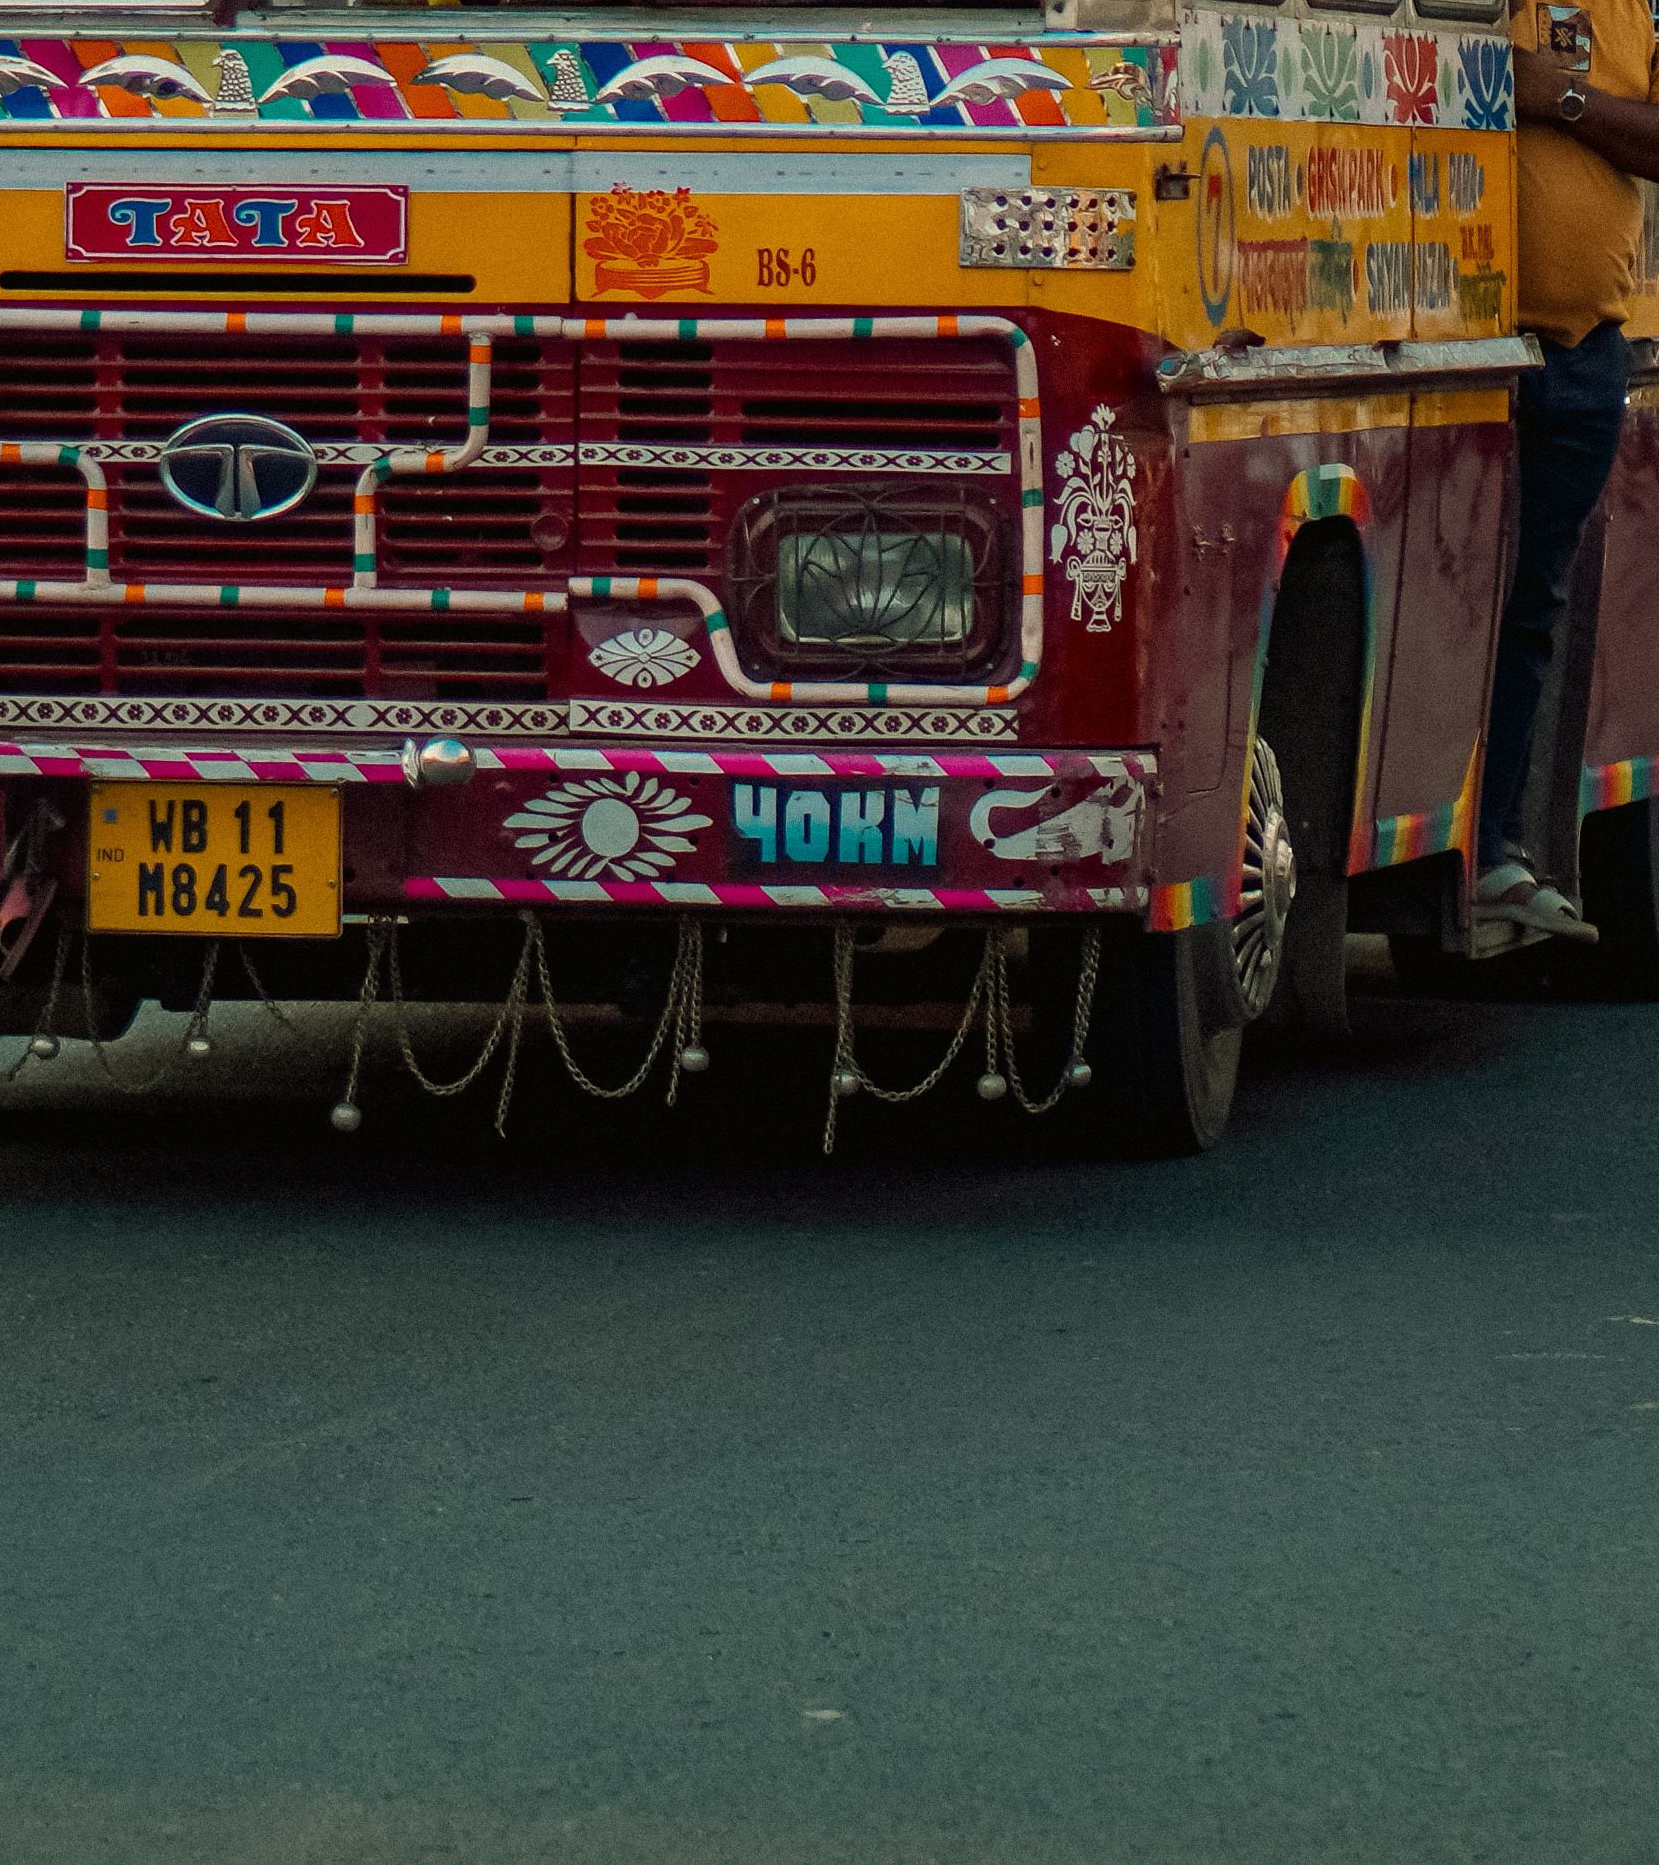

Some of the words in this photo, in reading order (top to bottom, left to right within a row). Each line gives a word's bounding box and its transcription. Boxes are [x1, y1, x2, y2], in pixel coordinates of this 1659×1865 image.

[109, 197, 366, 248] TATA
[756, 246, 818, 290] BS-6
[149, 798, 209, 854] WB
[235, 799, 285, 855] 11
[733, 782, 941, 867] 40KM
[96, 847, 126, 864] IND
[138, 861, 297, 918] M8425
